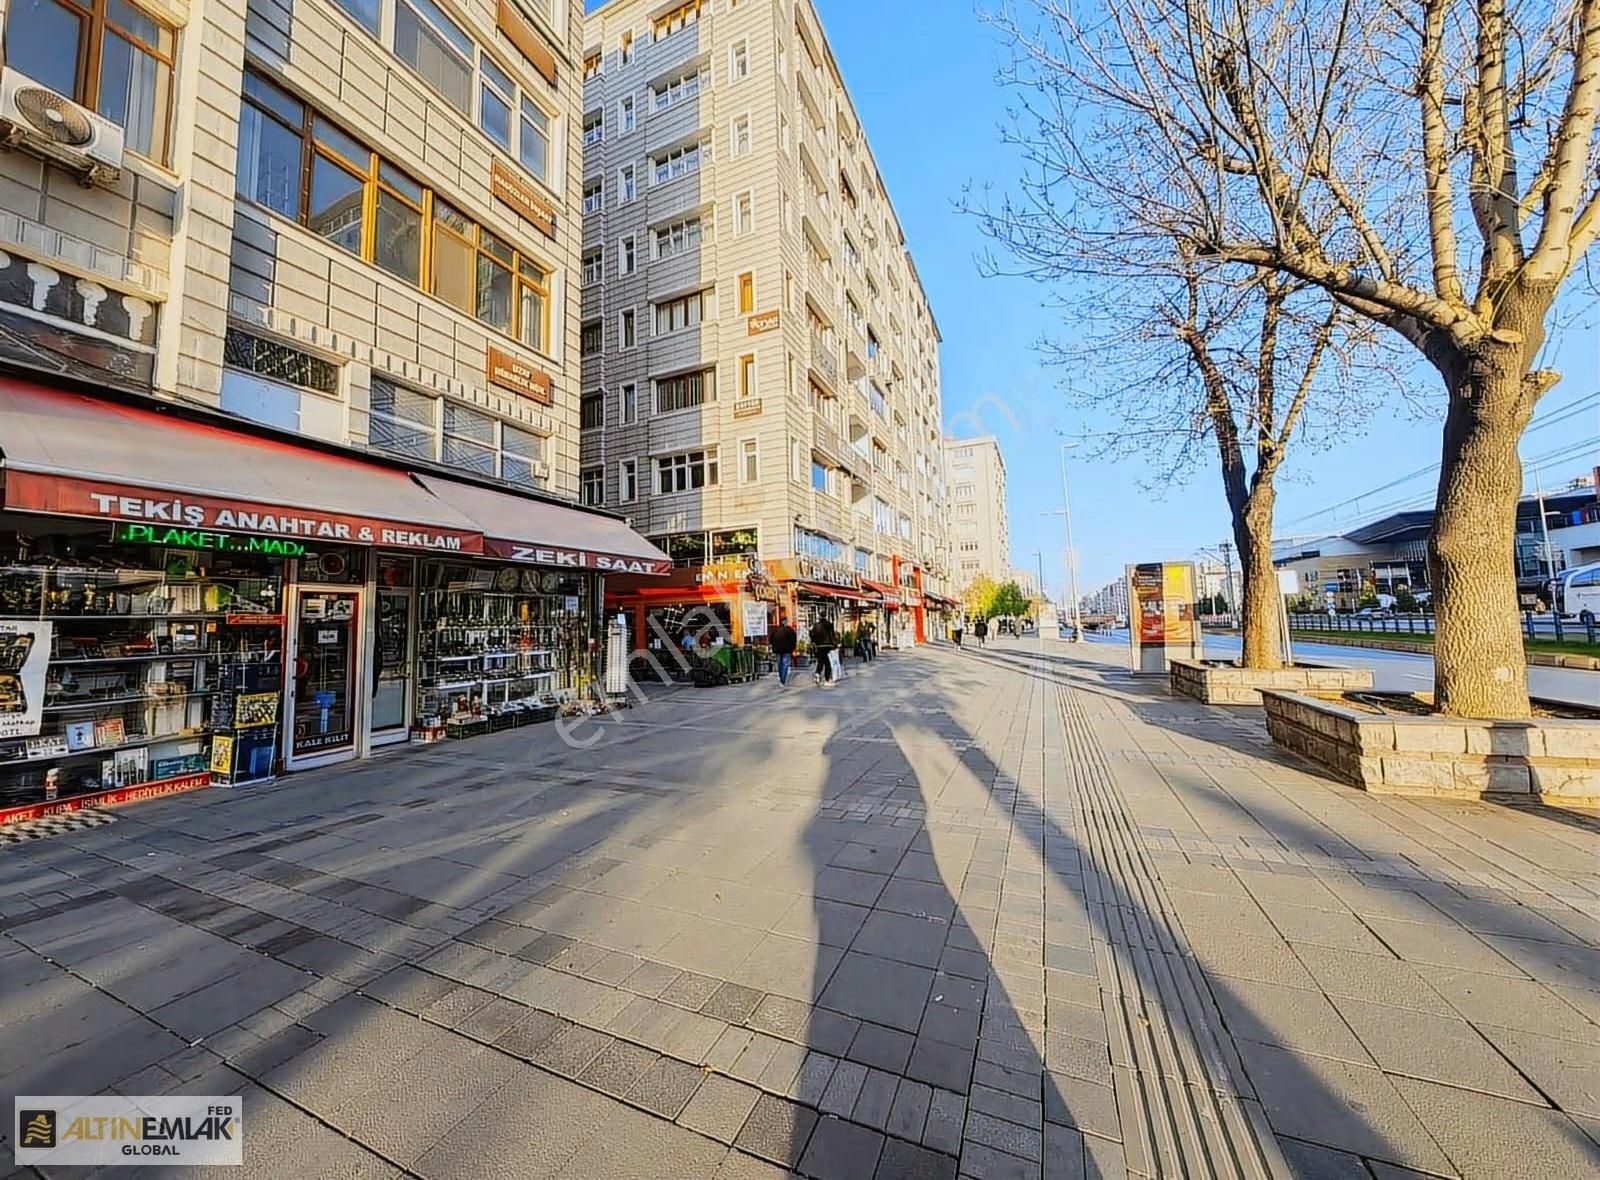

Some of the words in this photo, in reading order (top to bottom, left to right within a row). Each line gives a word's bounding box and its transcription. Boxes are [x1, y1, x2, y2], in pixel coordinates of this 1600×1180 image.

[90, 492, 205, 527] TEKİŞ
[214, 509, 351, 539] ANAHTAR
[358, 526, 375, 542] &
[381, 529, 461, 551] REKLAM
[511, 546, 586, 567] ZEKİ
[596, 558, 656, 574] SAAT
[43, 802, 74, 817] KUPA
[173, 778, 202, 793] KALEM
